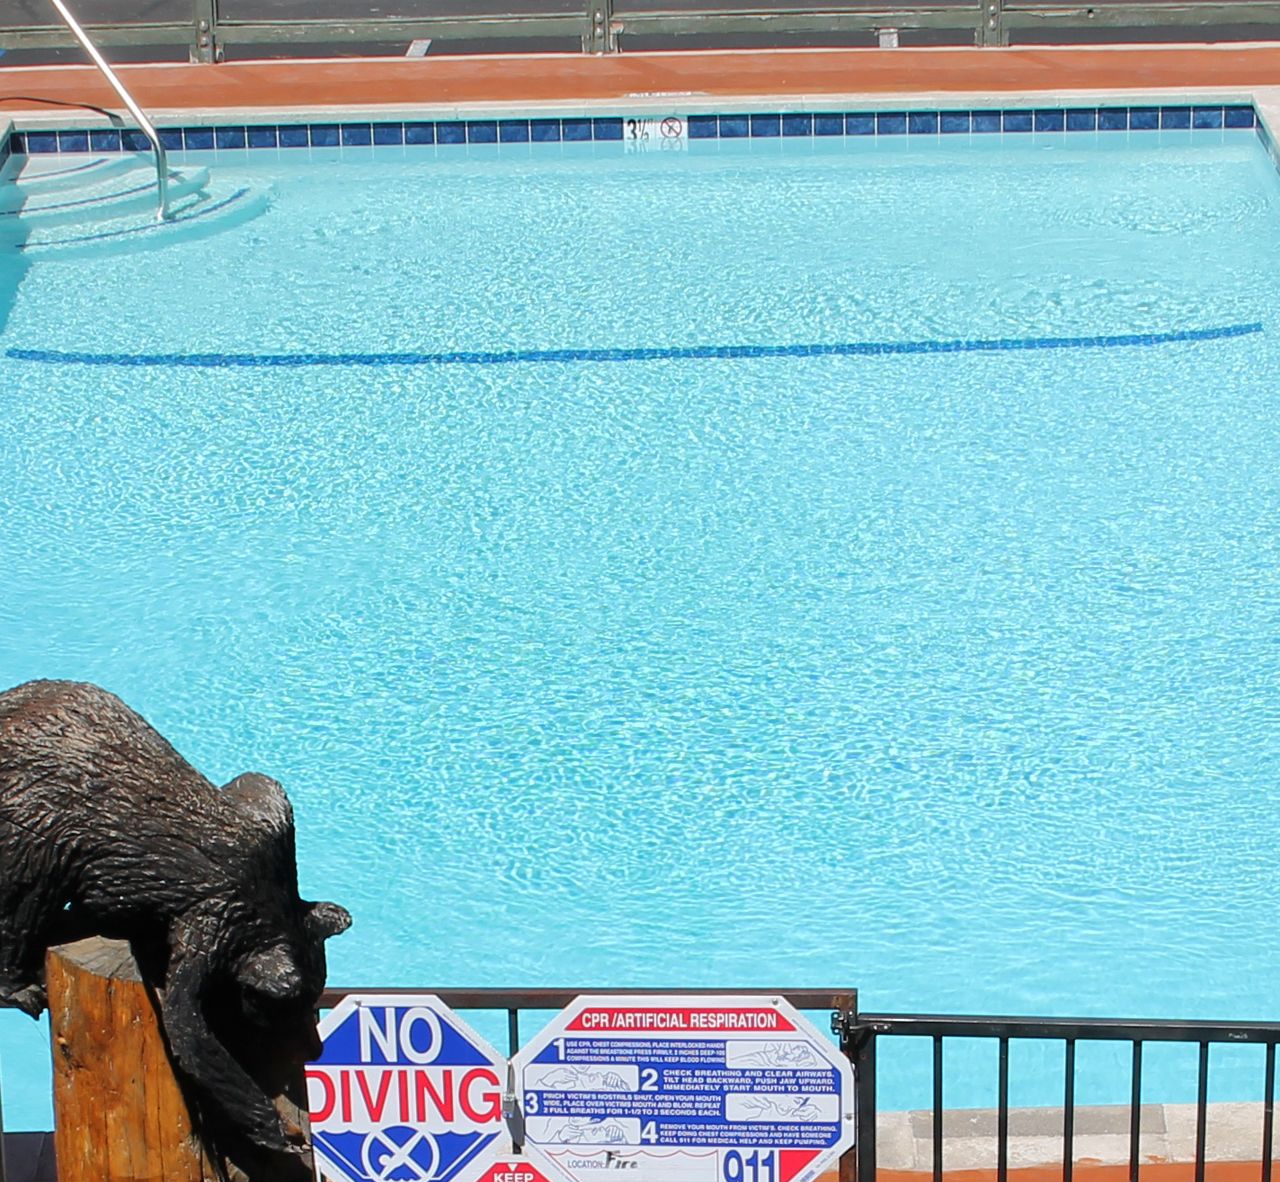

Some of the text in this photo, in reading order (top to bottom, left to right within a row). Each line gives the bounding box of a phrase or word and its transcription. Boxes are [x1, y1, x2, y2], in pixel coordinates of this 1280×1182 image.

[359, 1007, 442, 1064] NO
[582, 1013, 776, 1028] CPR /ARTIFICIAL RESPIRATION
[304, 1068, 502, 1124] DIVING
[642, 1069, 658, 1091] 2
